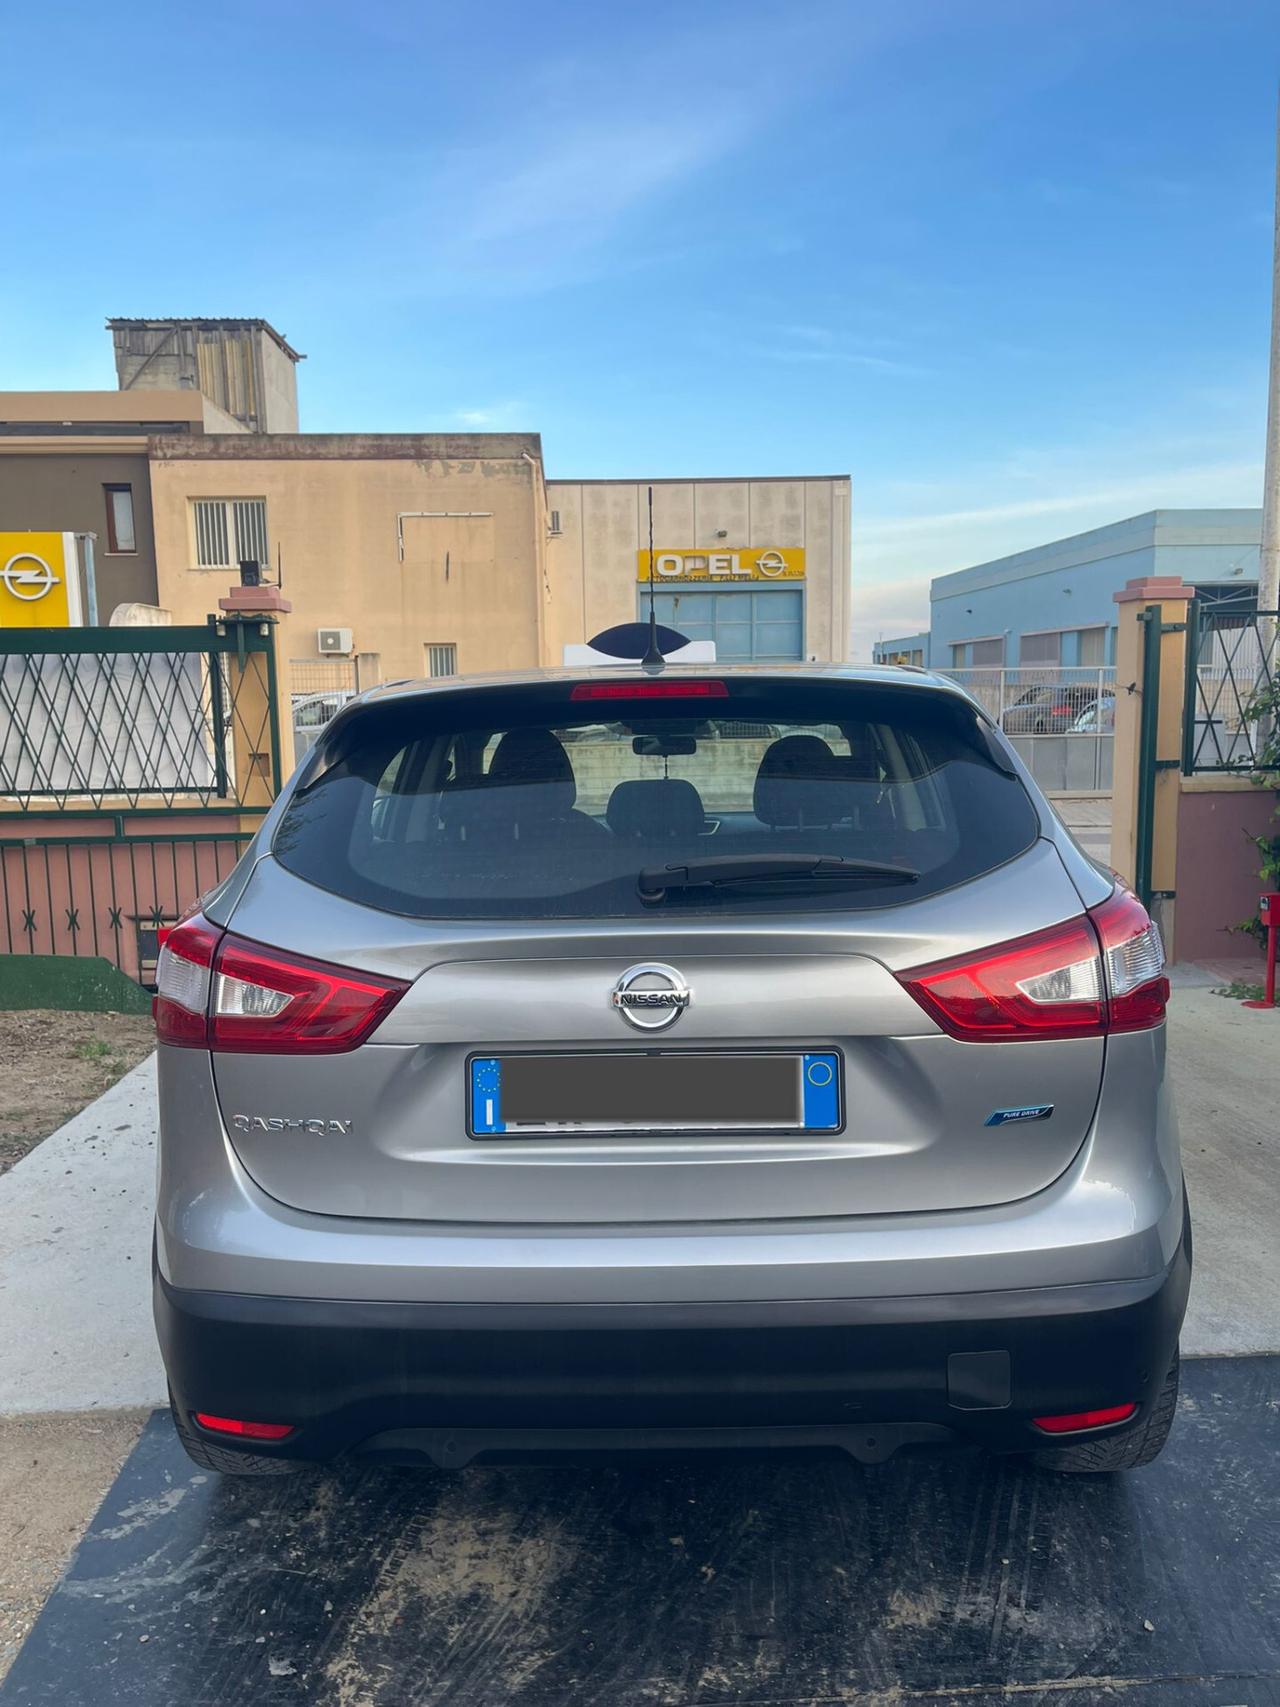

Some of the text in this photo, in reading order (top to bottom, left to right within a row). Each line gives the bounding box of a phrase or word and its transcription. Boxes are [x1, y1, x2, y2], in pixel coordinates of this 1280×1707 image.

[656, 554, 752, 576] OPEL
[620, 994, 682, 1006] NISSAN
[233, 1114, 352, 1136] QASHQAI
